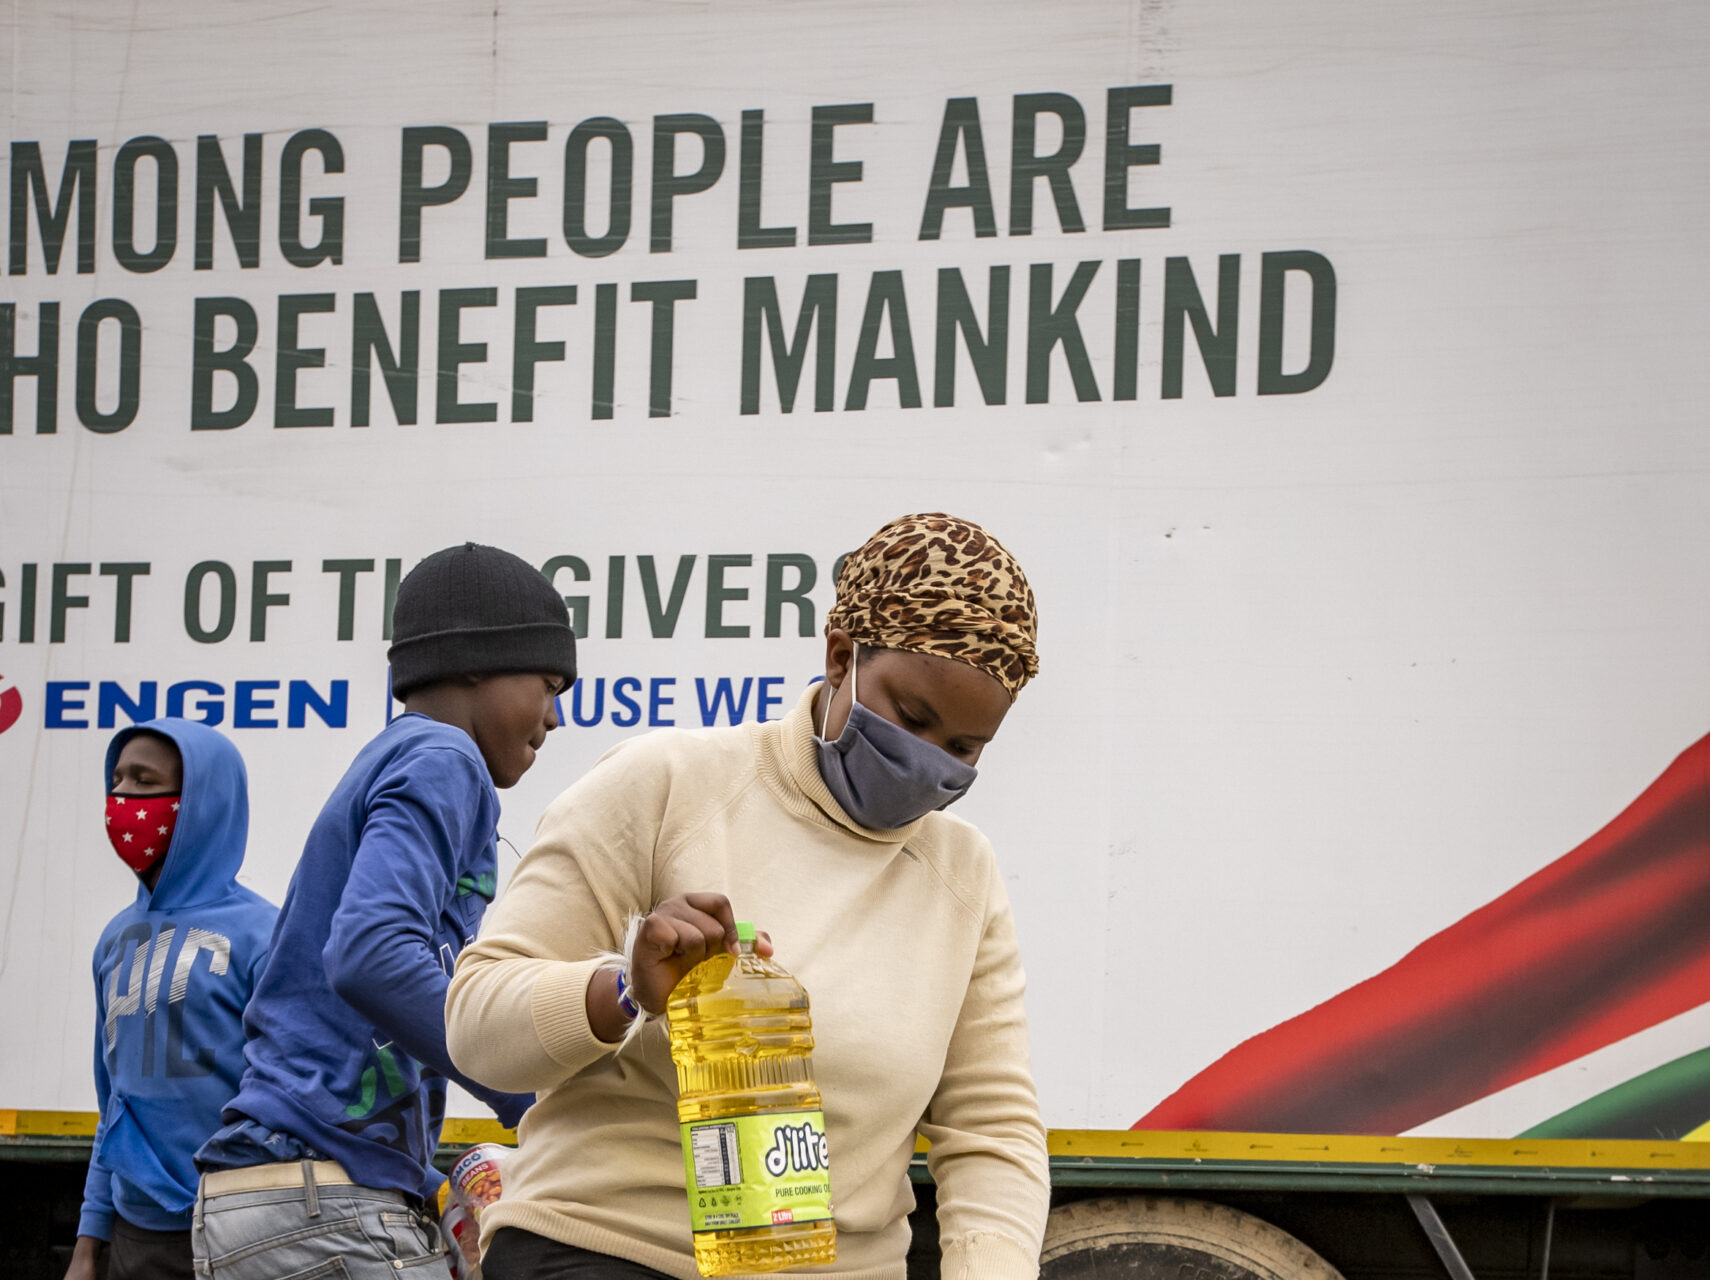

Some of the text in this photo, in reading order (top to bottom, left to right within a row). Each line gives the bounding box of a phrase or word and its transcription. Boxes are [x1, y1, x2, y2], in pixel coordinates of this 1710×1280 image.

[0, 84, 1174, 276] MONG PEOPLE ARE
[0, 250, 1337, 435] HO BENEFIT MANKIND
[0, 562, 151, 643] IFT
[184, 560, 293, 643] OF
[540, 552, 853, 640] GIVER
[44, 680, 348, 729] ENGEN
[695, 677, 785, 727] WE
[103, 922, 231, 1078] PIC
[775, 1187, 793, 1197] PURE
[795, 1185, 822, 1196] COOKING
